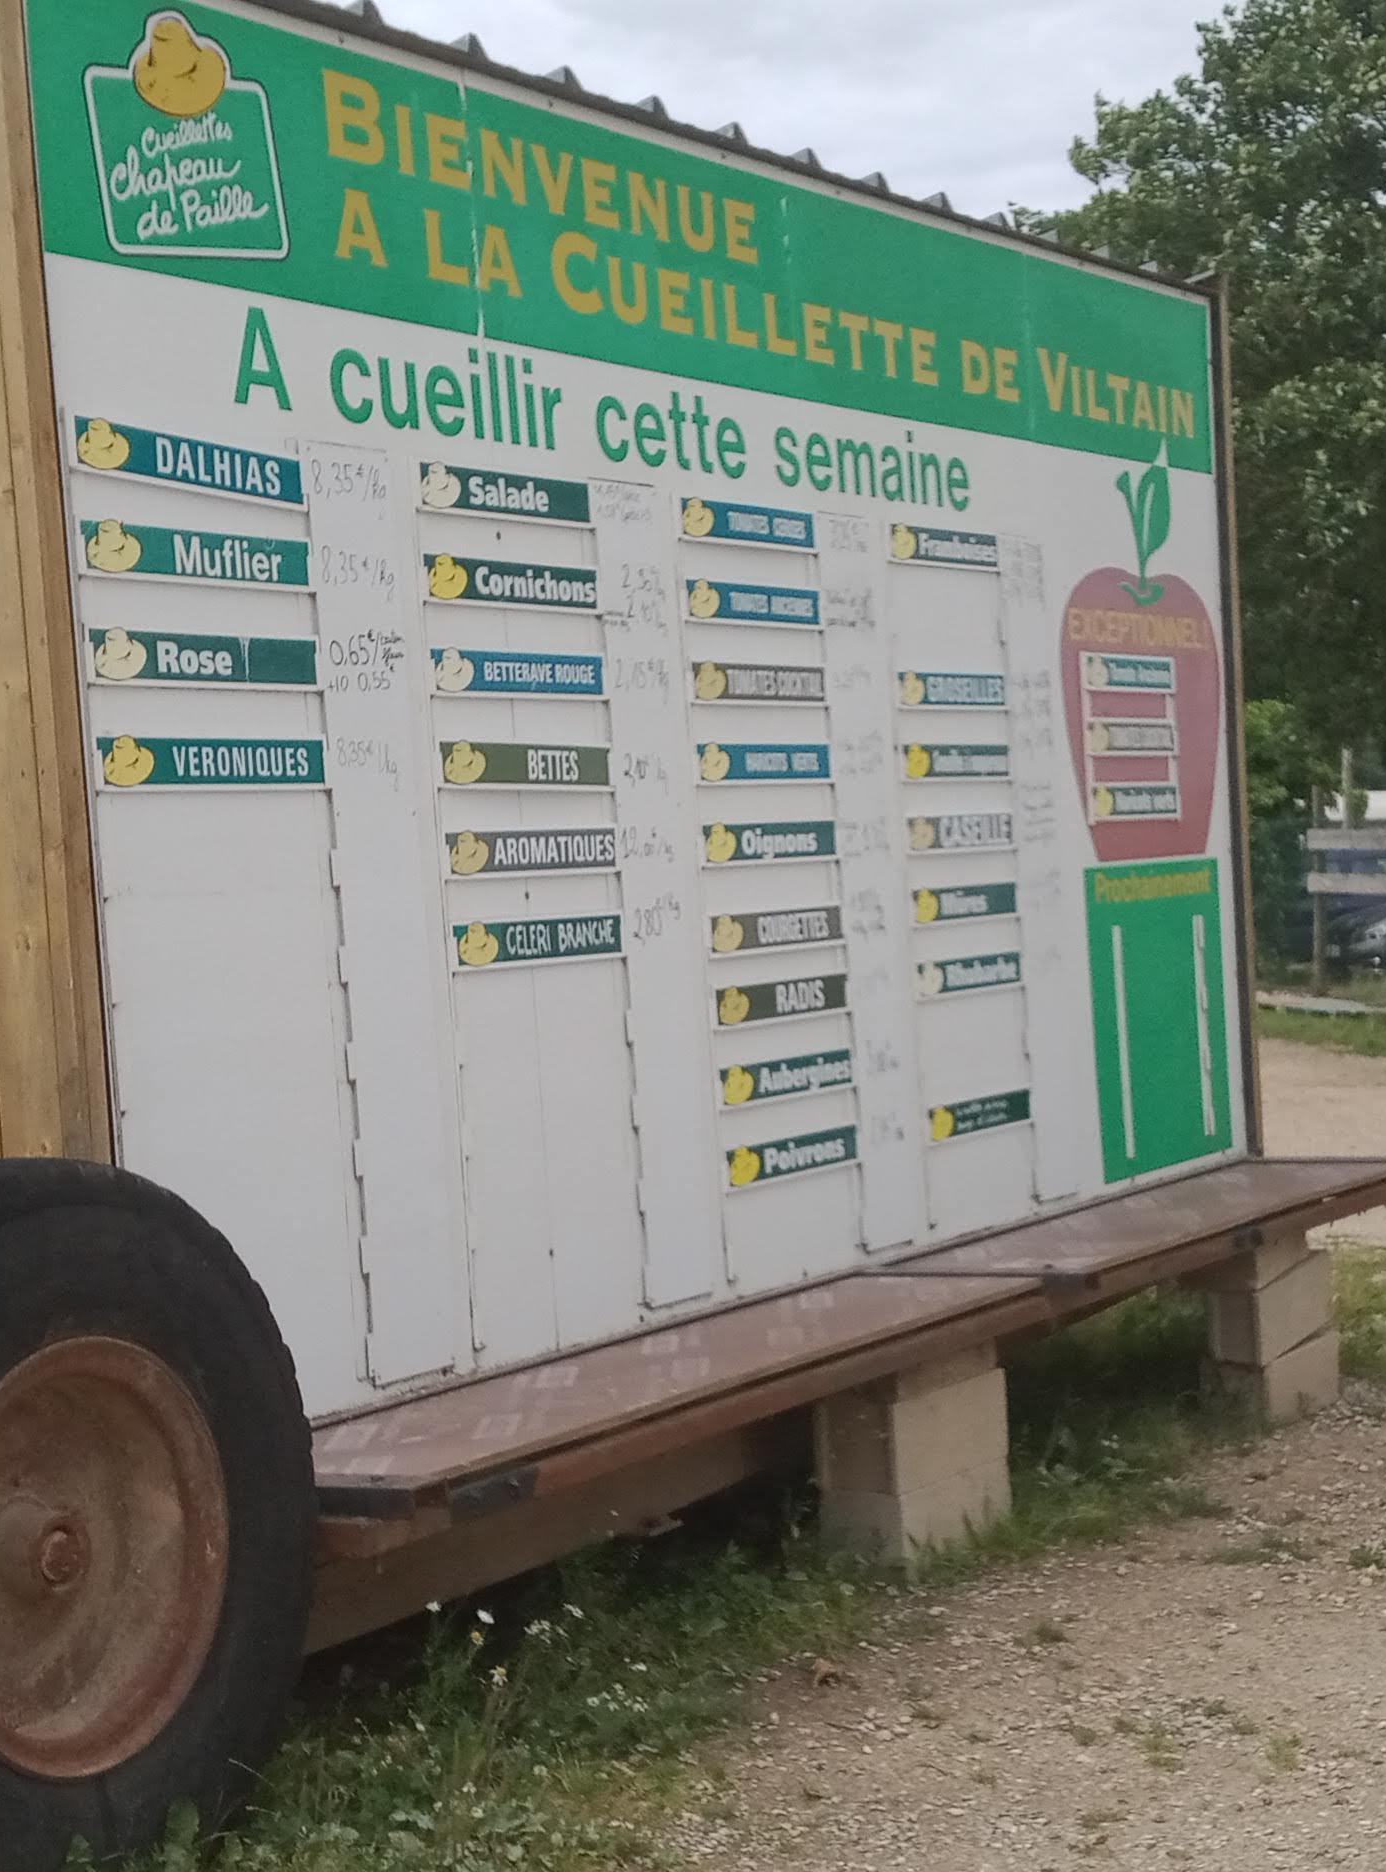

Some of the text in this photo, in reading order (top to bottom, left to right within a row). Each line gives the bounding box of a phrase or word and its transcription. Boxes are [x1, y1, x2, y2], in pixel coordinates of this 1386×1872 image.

[322, 67, 759, 265] BIENVENUE
[137, 184, 270, 240] de Paille
[335, 190, 1195, 439] A LA CUEILLETTE DE VILTAIN
[234, 306, 970, 512] A cueillir cette semaine
[155, 436, 282, 497] DALHIAS
[468, 476, 550, 512] Salade
[173, 534, 282, 583] Muflier
[475, 566, 597, 603] Cornichons
[156, 640, 233, 676] Rose
[483, 661, 596, 686] BETTERAVE ROUGE
[172, 745, 310, 777] VERONIQUES
[527, 749, 579, 781] BETTES
[494, 834, 615, 866] AROMATIQUES
[741, 828, 818, 860] Oignons
[506, 919, 615, 955] CELERI BRANCHE
[776, 980, 825, 1014] RADIS
[758, 1056, 852, 1093] Aubergines
[764, 1137, 845, 1174] Poivrons
